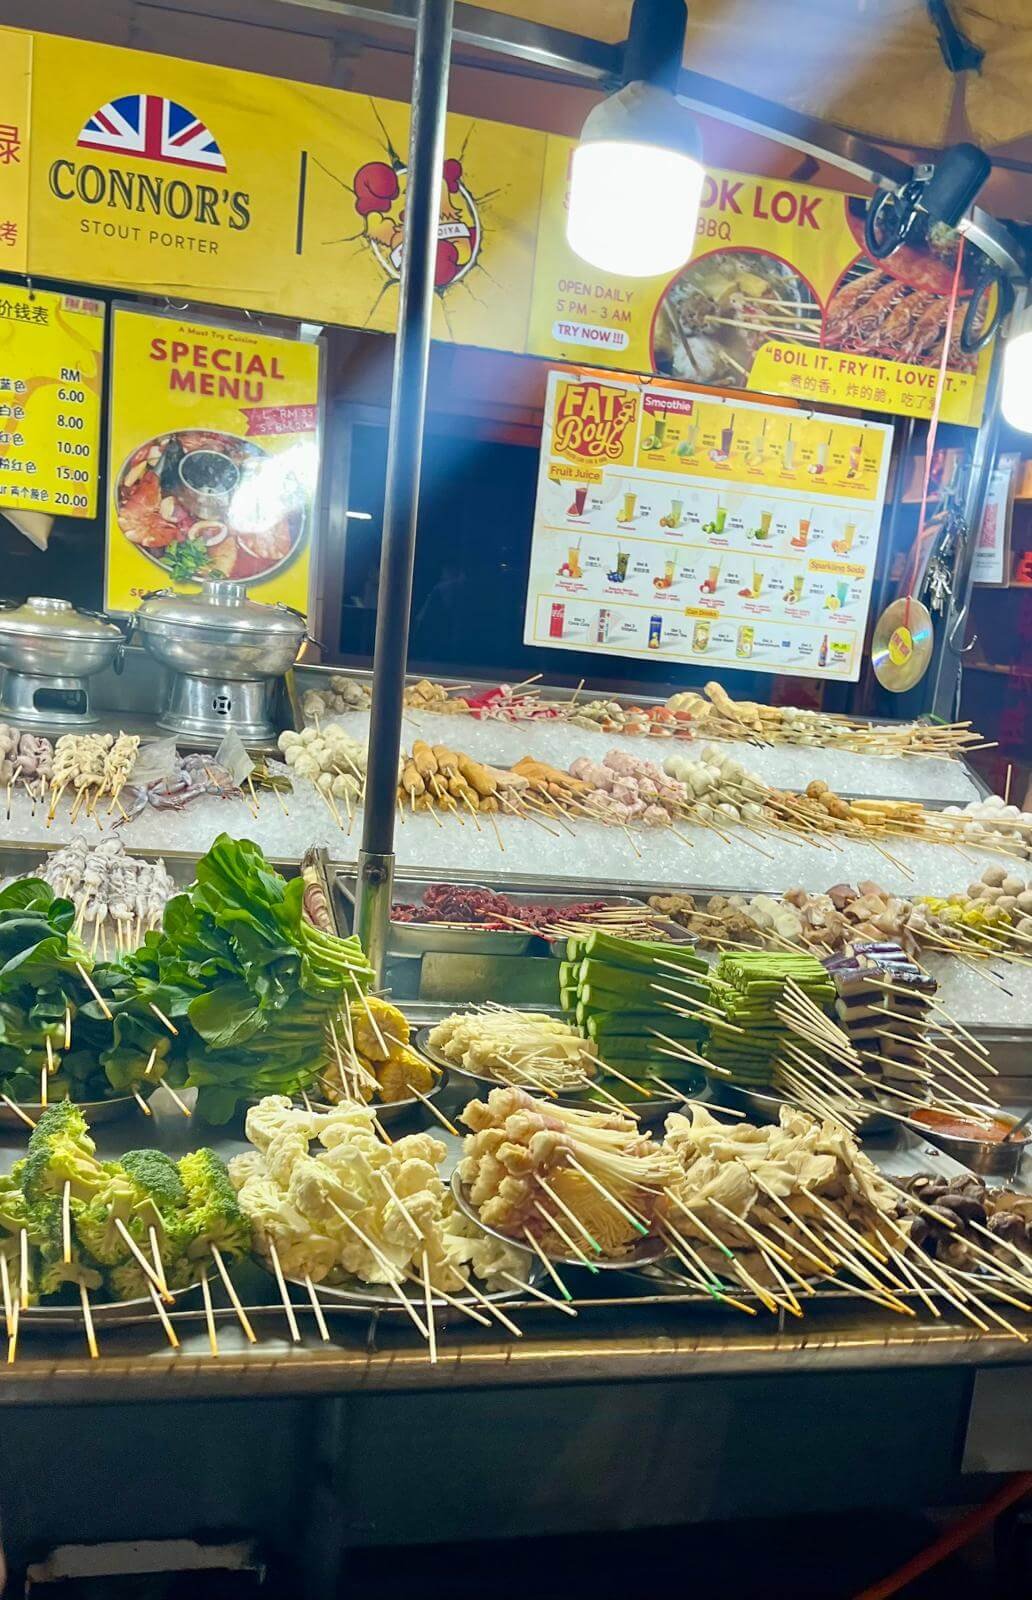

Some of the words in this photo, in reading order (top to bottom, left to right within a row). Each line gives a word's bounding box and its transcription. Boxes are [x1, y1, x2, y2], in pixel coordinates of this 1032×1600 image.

[49, 159, 250, 231] CONNOR'S
[753, 186, 823, 230] LOK
[80, 219, 141, 241] STOUT
[150, 231, 219, 255] PORTER
[696, 217, 732, 241] BBQ
[558, 279, 592, 297] OPEN
[595, 286, 634, 302] DAILY
[556, 301, 564, 312] 5
[569, 303, 588, 316] PM
[600, 307, 609, 319] 3
[612, 309, 632, 322] AM
[188, 327, 208, 337] Must
[212, 331, 225, 341] Try
[558, 324, 580, 337] TRY
[582, 329, 610, 342] NOW
[149, 338, 285, 380] SPECIAL
[60, 368, 80, 382] RM
[814, 356, 833, 371] IT.
[839, 359, 868, 376] FRY
[873, 366, 891, 381] IT.
[896, 369, 935, 388] LOVE
[169, 368, 264, 403] MENU
[58, 388, 84, 403] 6.00
[563, 384, 628, 423] FAT
[645, 396, 691, 411] Smoothie
[57, 415, 84, 430] 8.00
[57, 441, 90, 456] 10.00
[57, 467, 89, 482] 15.00
[550, 466, 573, 477] Fruit
[575, 468, 600, 480] Juice
[55, 492, 88, 507] 20.00
[811, 560, 846, 576] Sparkling
[848, 564, 865, 574] Soda
